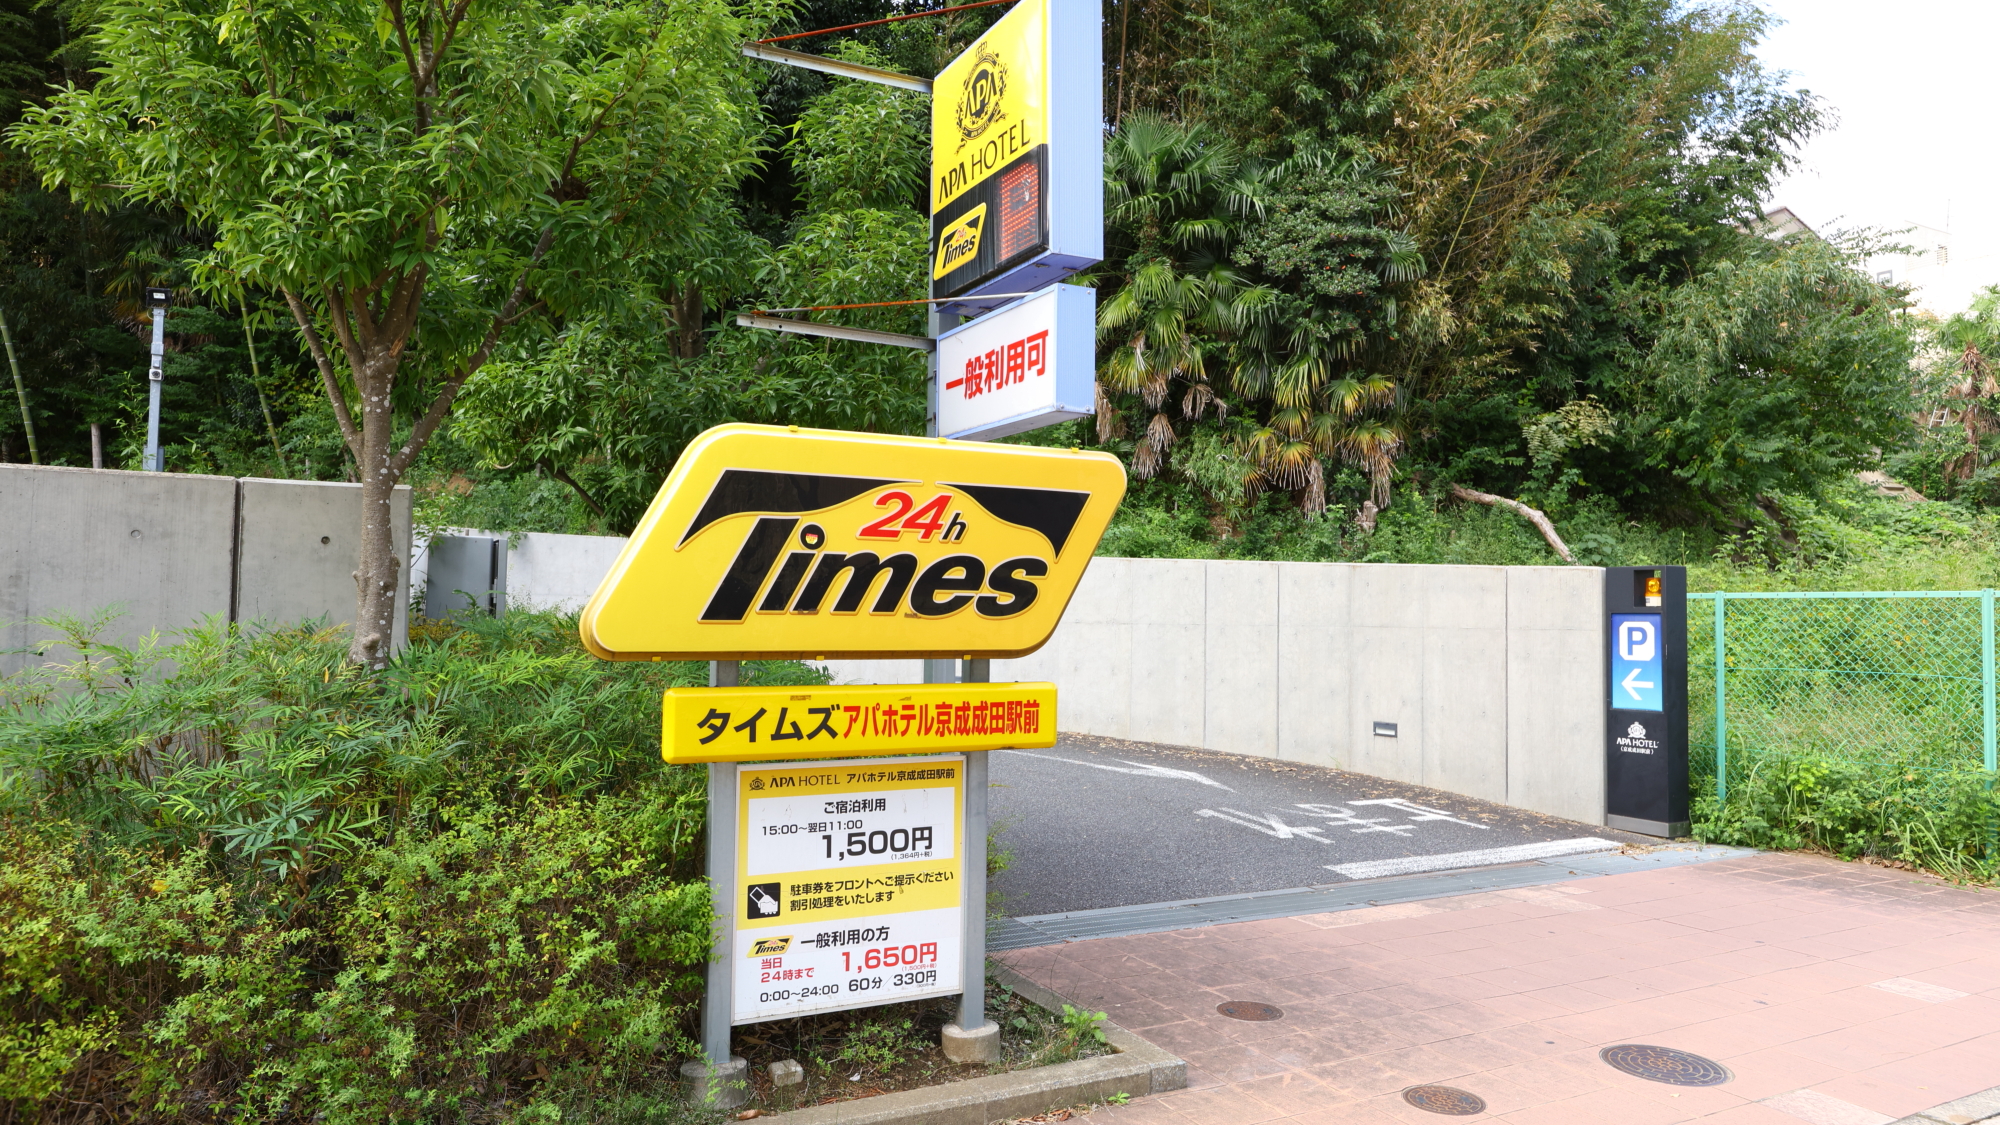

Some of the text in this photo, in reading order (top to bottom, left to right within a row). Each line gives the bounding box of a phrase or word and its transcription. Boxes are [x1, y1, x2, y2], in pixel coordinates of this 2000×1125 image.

[939, 119, 1031, 204] APA HOTEL
[942, 235, 976, 269] Times
[945, 329, 1049, 400] 一般利用可
[857, 490, 967, 541] 24h
[698, 517, 1049, 621] Times
[1627, 626, 1648, 656] P
[1616, 737, 1658, 749] APA HOTEL
[769, 776, 796, 788] APA
[798, 774, 841, 787] HOTEL
[846, 768, 955, 784] アパホテル京成成田駅前
[824, 798, 886, 814] ご宿泊利用
[822, 826, 933, 861] 1,500円
[790, 871, 954, 897] 駐車券をフロントへご提示ください
[790, 891, 895, 912] 割引処理をいたします
[755, 944, 786, 955] Times
[800, 926, 890, 949] 一般利用の方
[761, 957, 783, 970] 当日
[842, 942, 938, 974] 1,650円
[761, 968, 815, 983] 24時まで
